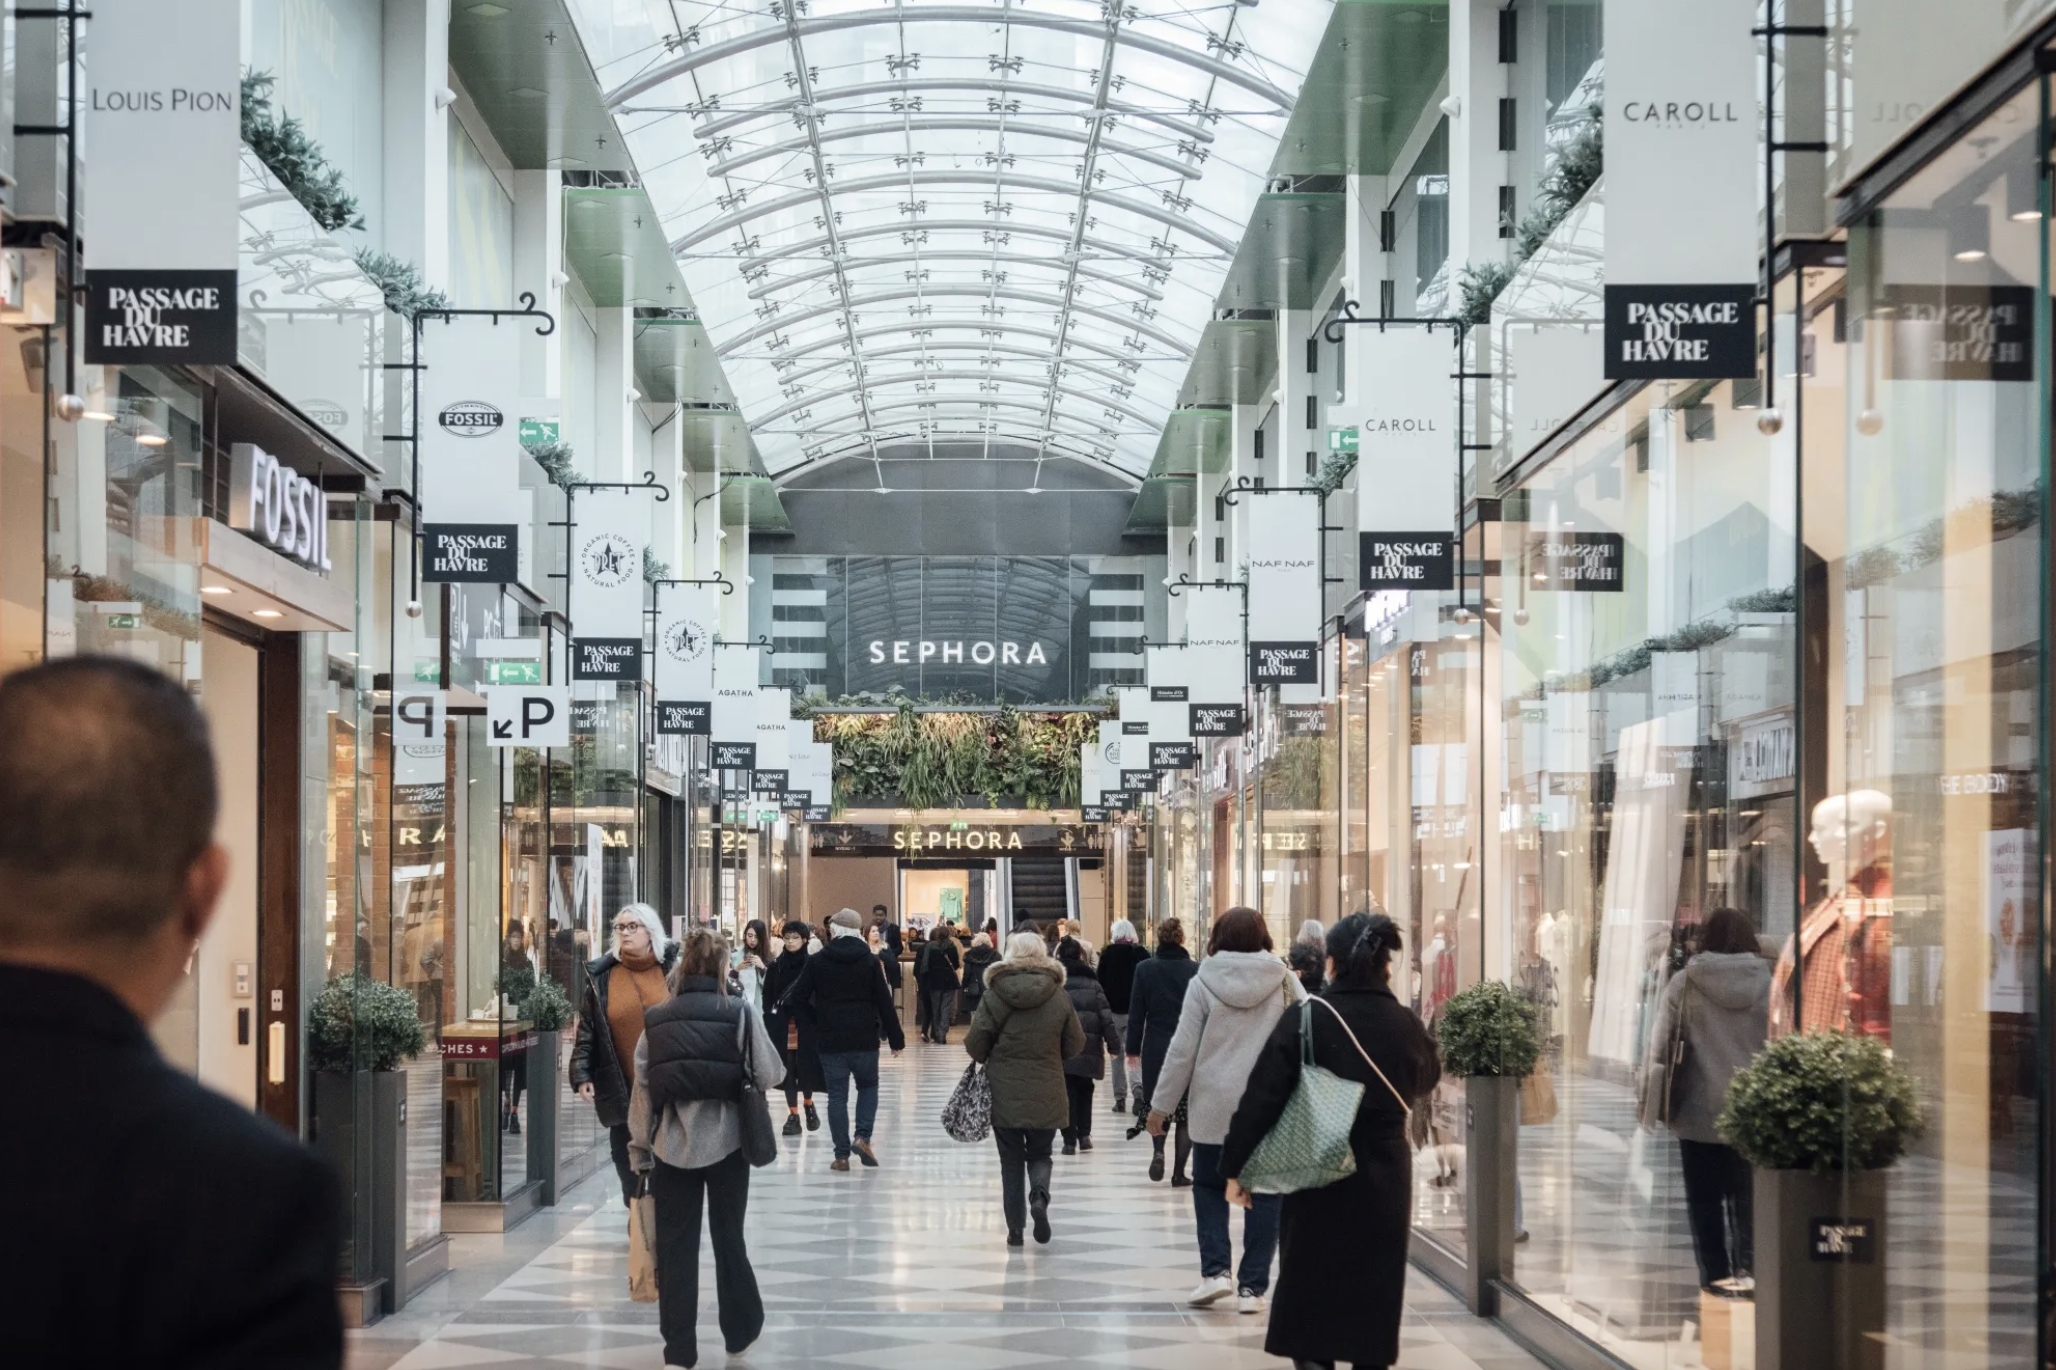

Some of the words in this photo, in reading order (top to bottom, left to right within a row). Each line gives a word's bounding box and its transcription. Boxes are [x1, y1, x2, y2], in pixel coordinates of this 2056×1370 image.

[1624, 102, 1738, 121] CAROLL
[109, 287, 219, 309] PASSAGE
[125, 306, 161, 328] DU
[1628, 303, 1738, 324] PASSAGE
[103, 325, 189, 346] HAVRE
[1645, 320, 1680, 342] DU
[1623, 340, 1709, 361] HAVRE
[445, 413, 498, 425] FOSSIL
[1366, 419, 1436, 431] CAROLL
[249, 444, 331, 571] FOSSIL
[438, 535, 506, 549] PASSAGE
[447, 547, 470, 560] DU
[1374, 543, 1443, 556] PASSAGE
[434, 558, 488, 571] HAVRE
[594, 551, 622, 571] PRET
[1252, 560, 1282, 568] NAF
[1285, 560, 1315, 568] NAF
[1384, 554, 1407, 568] DU
[1370, 566, 1424, 579] HAVRE
[584, 646, 634, 656] PASSAGE
[869, 640, 1047, 664] SEPHORA
[1260, 649, 1310, 659] PASSAGE
[591, 654, 607, 664] DU
[1267, 657, 1284, 668] DU
[581, 662, 620, 672] HAVRE
[1257, 666, 1297, 676] HAVRE
[718, 689, 753, 697] AGATHA
[522, 697, 554, 738] P
[665, 707, 705, 716] PASSAGE
[1197, 710, 1236, 718] PASSAGE
[663, 720, 694, 729] HAVRE
[1195, 722, 1226, 731] HAVRE
[718, 747, 751, 755] PASSAGE
[893, 831, 1023, 850] SEPHORA
